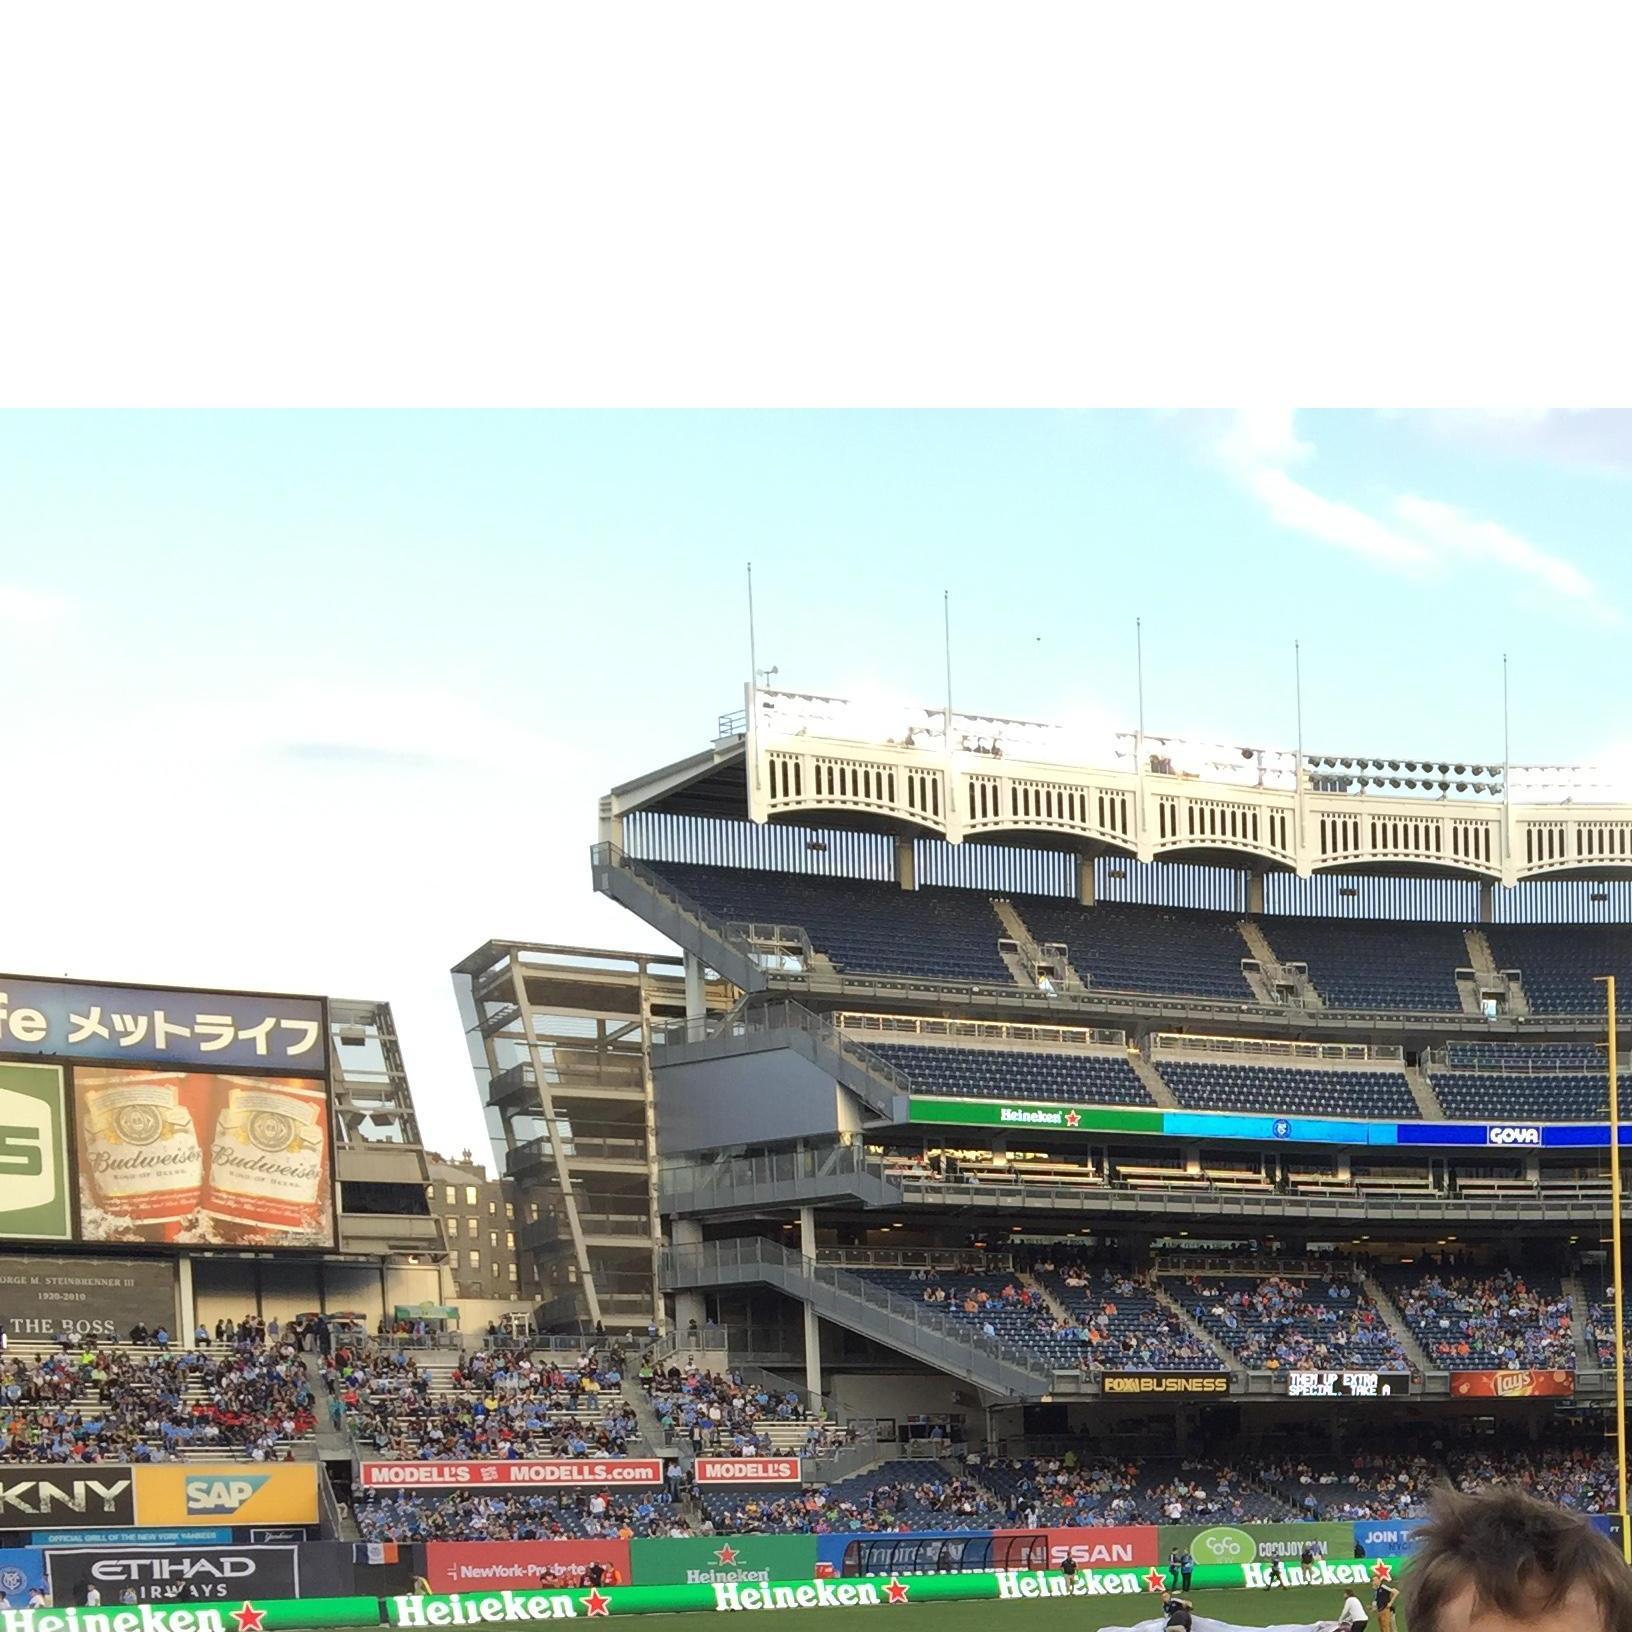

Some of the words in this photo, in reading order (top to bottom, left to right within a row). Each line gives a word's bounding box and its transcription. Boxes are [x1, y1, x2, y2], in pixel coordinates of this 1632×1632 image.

[68, 1006, 319, 1056] メットライフ
[1001, 1108, 1063, 1124] Heineken
[1490, 1128, 1538, 1144] GOYA
[45, 1277, 121, 1287] STEINBRENNER
[10, 1319, 53, 1333] THE
[62, 1319, 115, 1334] BOSS
[1140, 1378, 1227, 1392] BUSINESS
[1343, 1373, 1378, 1385] EXTRA
[1350, 1385, 1377, 1396] TAKE
[1382, 1383, 1391, 1396] A
[371, 1464, 471, 1483] MODELL'S
[509, 1463, 654, 1482] MODELLS.com
[704, 1462, 791, 1479] MODELL'S
[187, 1481, 253, 1509] SAP
[1365, 1531, 1398, 1543] JOIN
[1022, 1544, 1133, 1563] NISSAN
[91, 1557, 257, 1580] ETIHAD
[686, 1567, 767, 1584] Heineken
[141, 1583, 229, 1599] IRWAYS
[713, 1578, 880, 1612] Heineken
